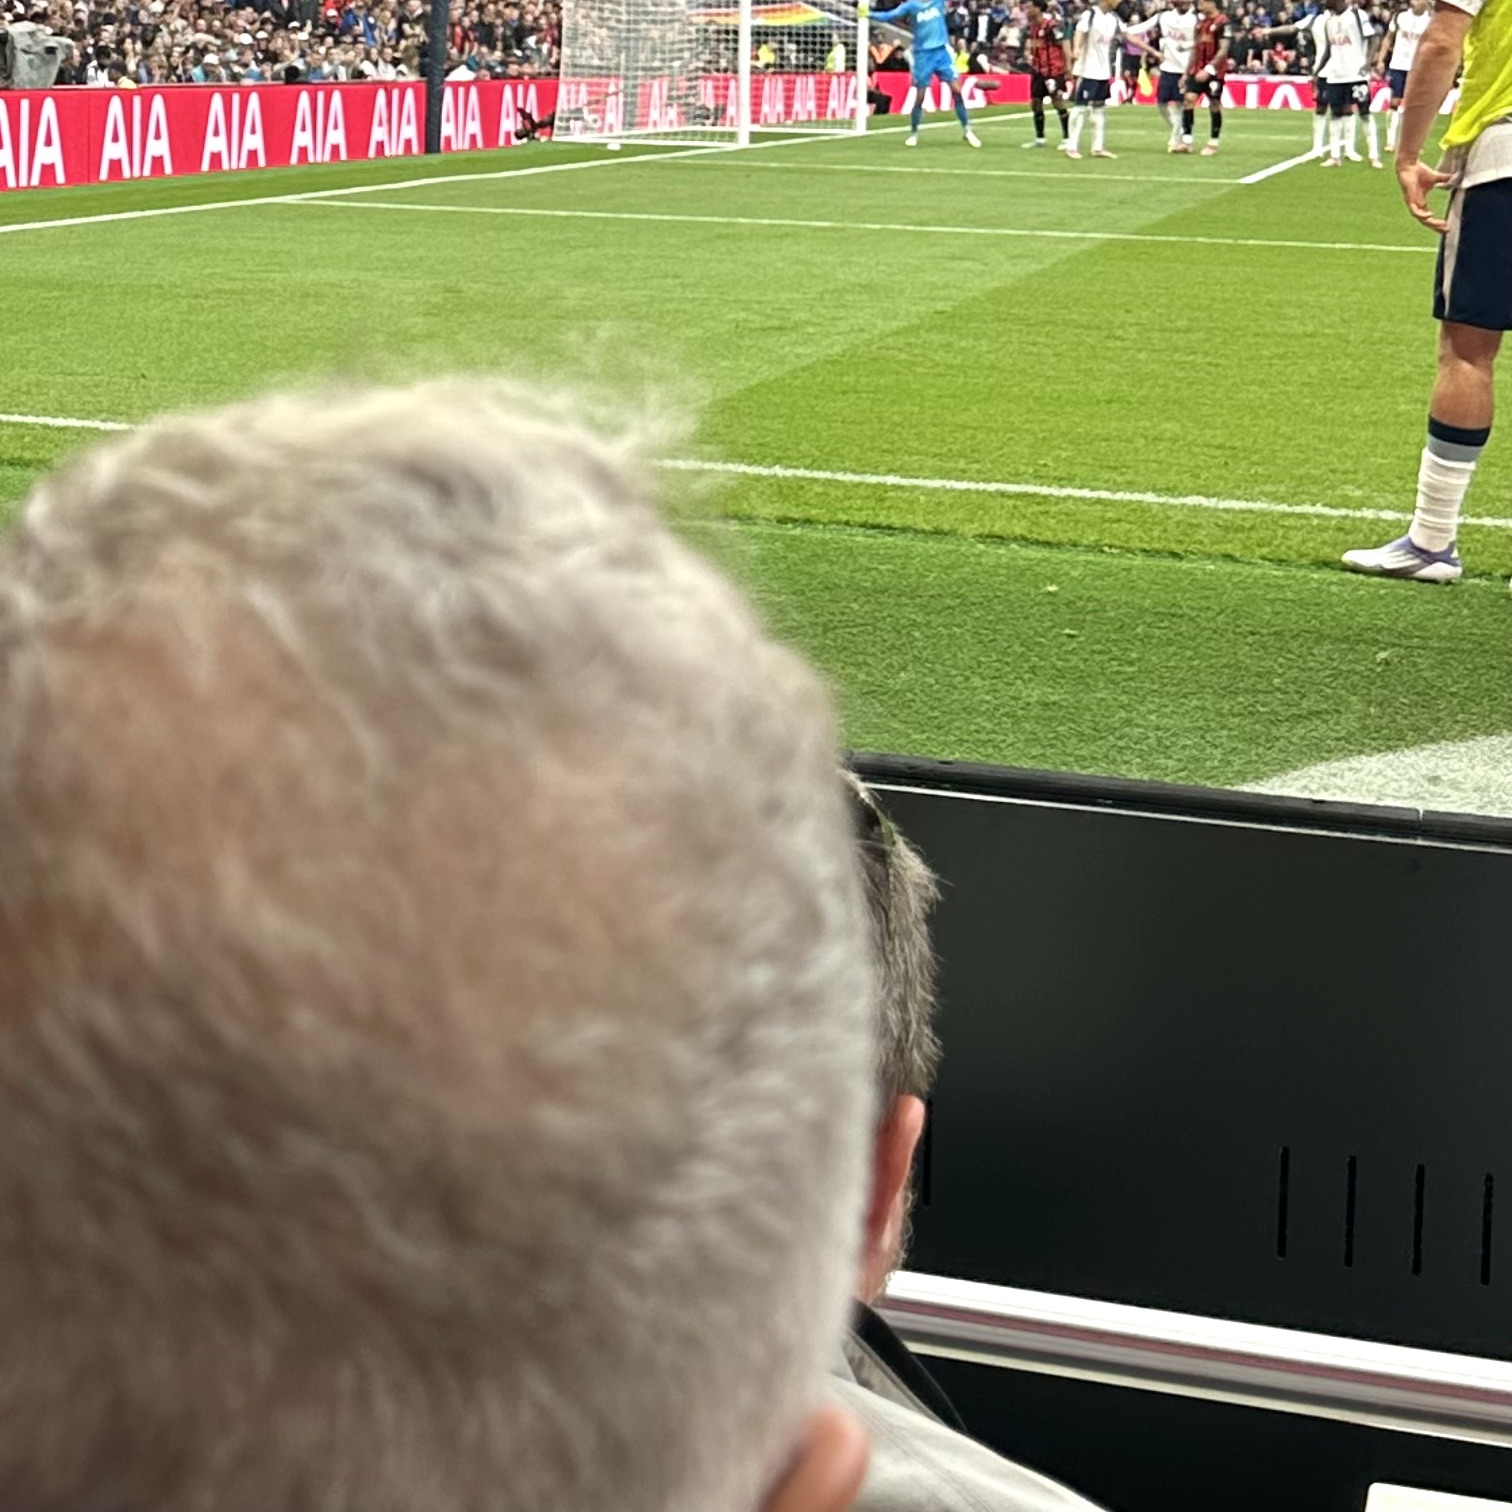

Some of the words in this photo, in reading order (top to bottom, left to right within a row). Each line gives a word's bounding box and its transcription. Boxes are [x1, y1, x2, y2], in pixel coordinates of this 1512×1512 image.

[99, 93, 172, 182] AIA
[200, 91, 266, 172] AIA
[290, 89, 347, 165] AIA
[368, 87, 419, 158] AIA
[441, 85, 483, 152] AIA
